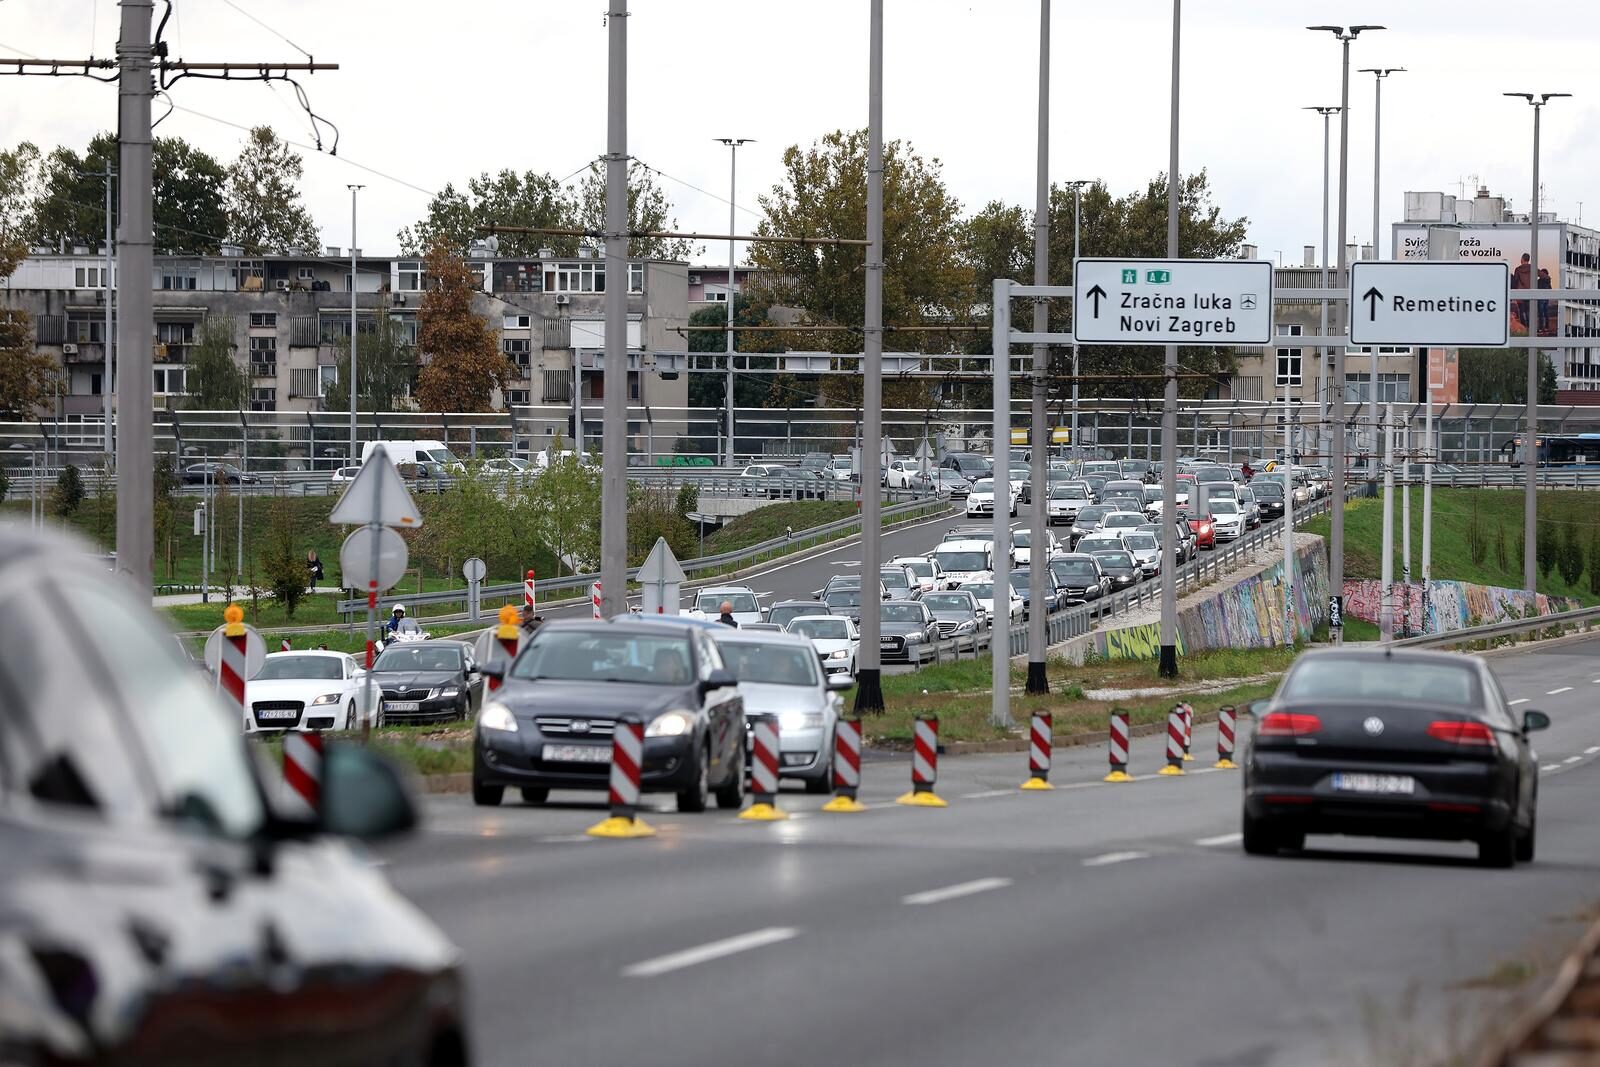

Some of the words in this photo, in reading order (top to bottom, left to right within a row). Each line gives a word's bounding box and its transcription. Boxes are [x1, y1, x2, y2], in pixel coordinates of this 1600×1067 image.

[1459, 237, 1481, 247] reža
[1472, 247, 1502, 257] vozila
[1120, 292, 1185, 309] Zračna
[1194, 293, 1231, 310] luka
[1393, 296, 1497, 312] Remetinec
[1120, 316, 1160, 332] Novi
[1168, 316, 1236, 336] Zagreb
